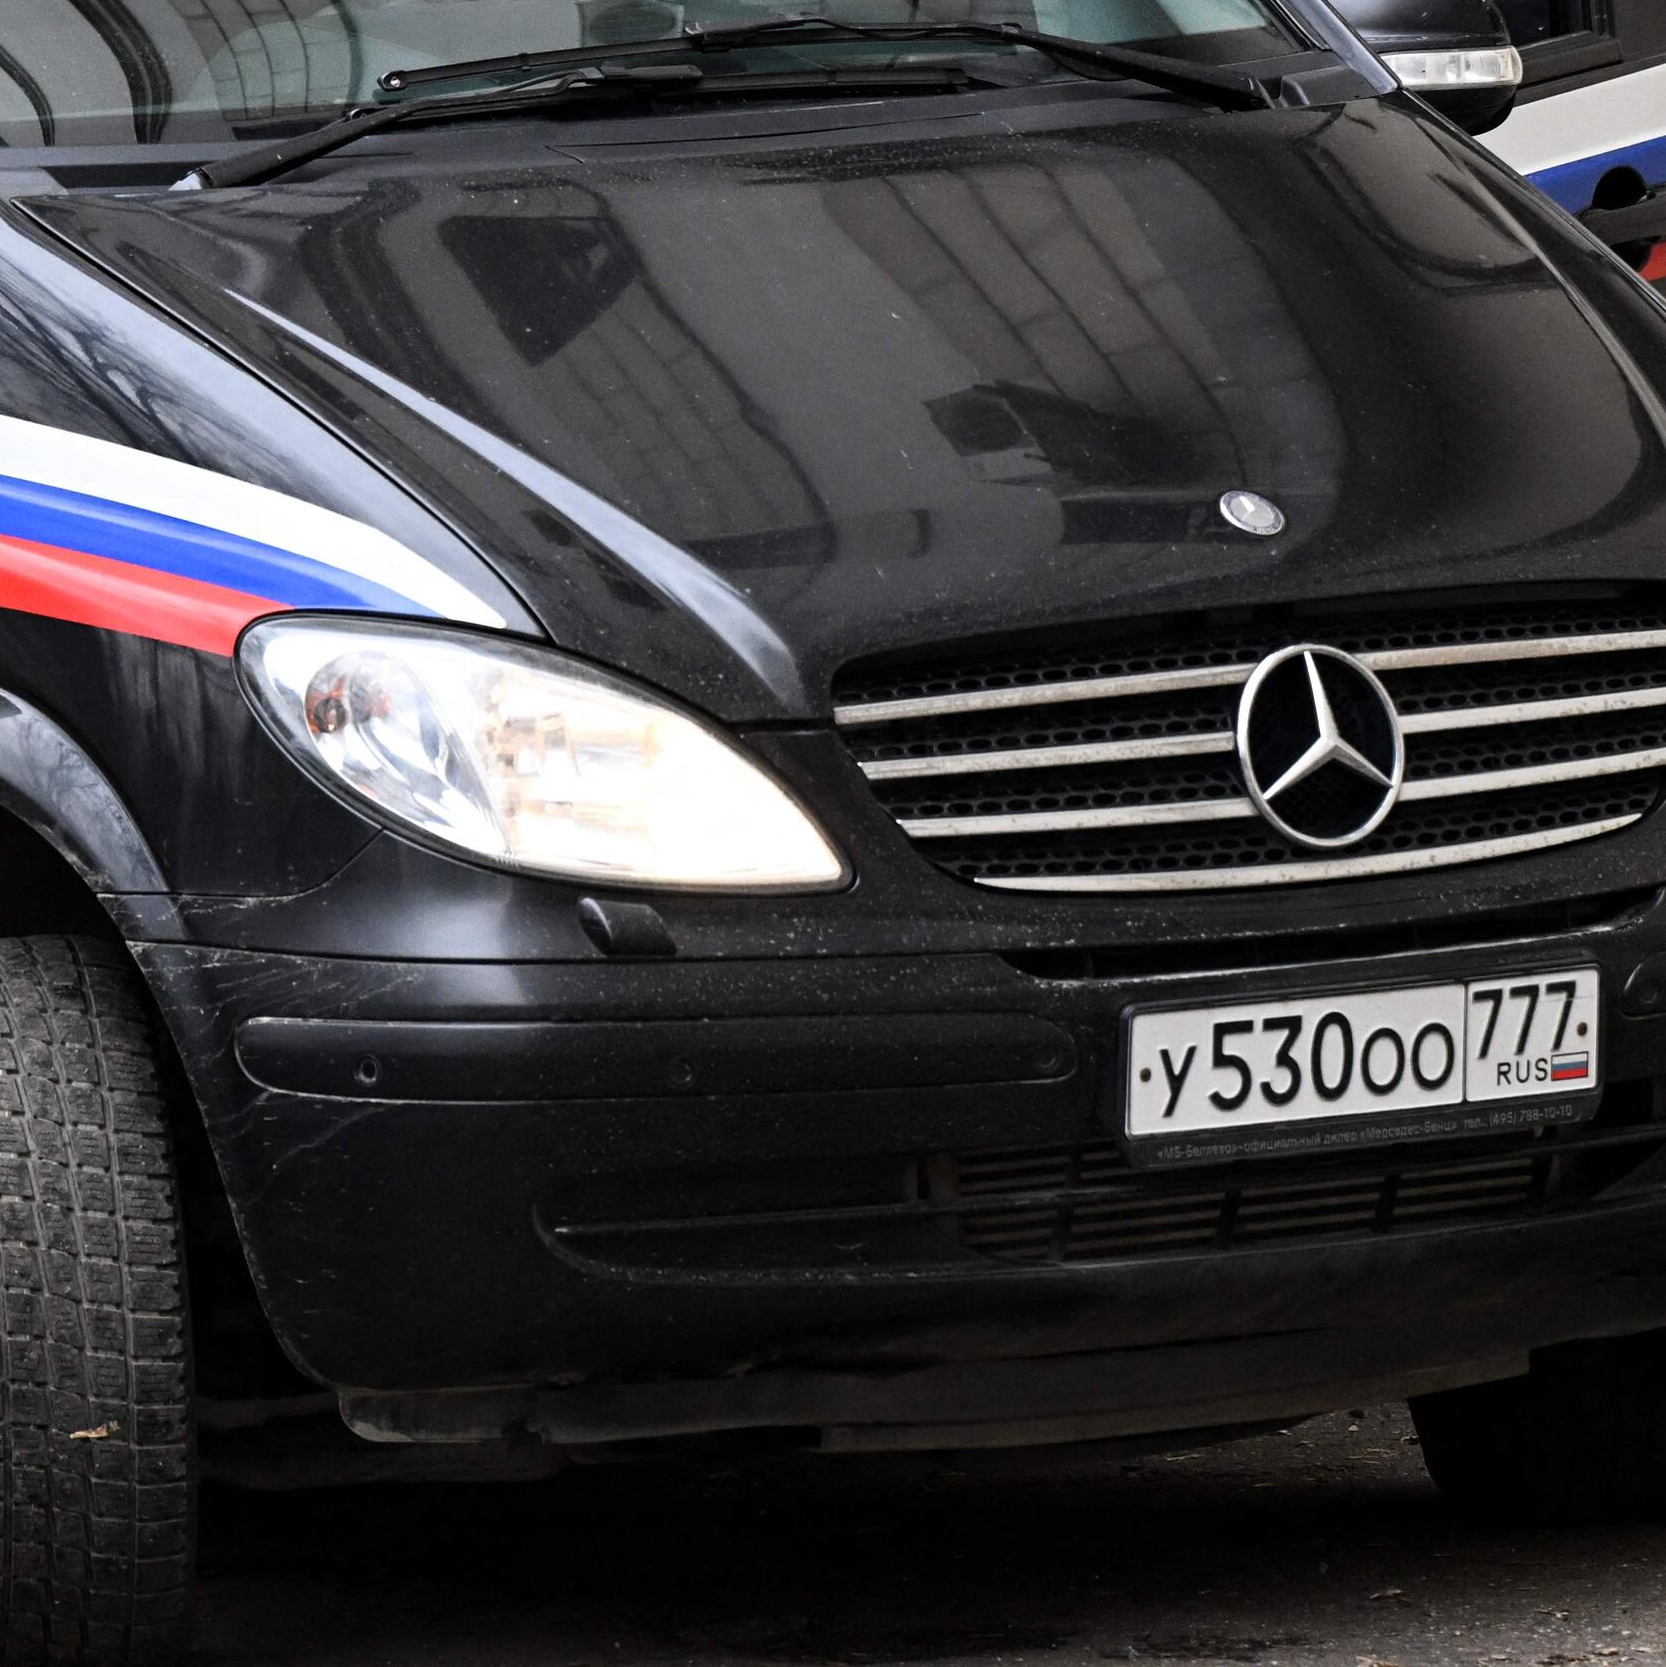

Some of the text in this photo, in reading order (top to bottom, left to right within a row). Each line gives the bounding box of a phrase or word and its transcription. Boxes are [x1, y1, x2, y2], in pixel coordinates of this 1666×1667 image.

[1472, 980, 1577, 1060] 777
[1496, 1057, 1549, 1086] RUS
[1489, 1111, 1517, 1128] (495)
[1519, 1105, 1573, 1123] 788-10-10
